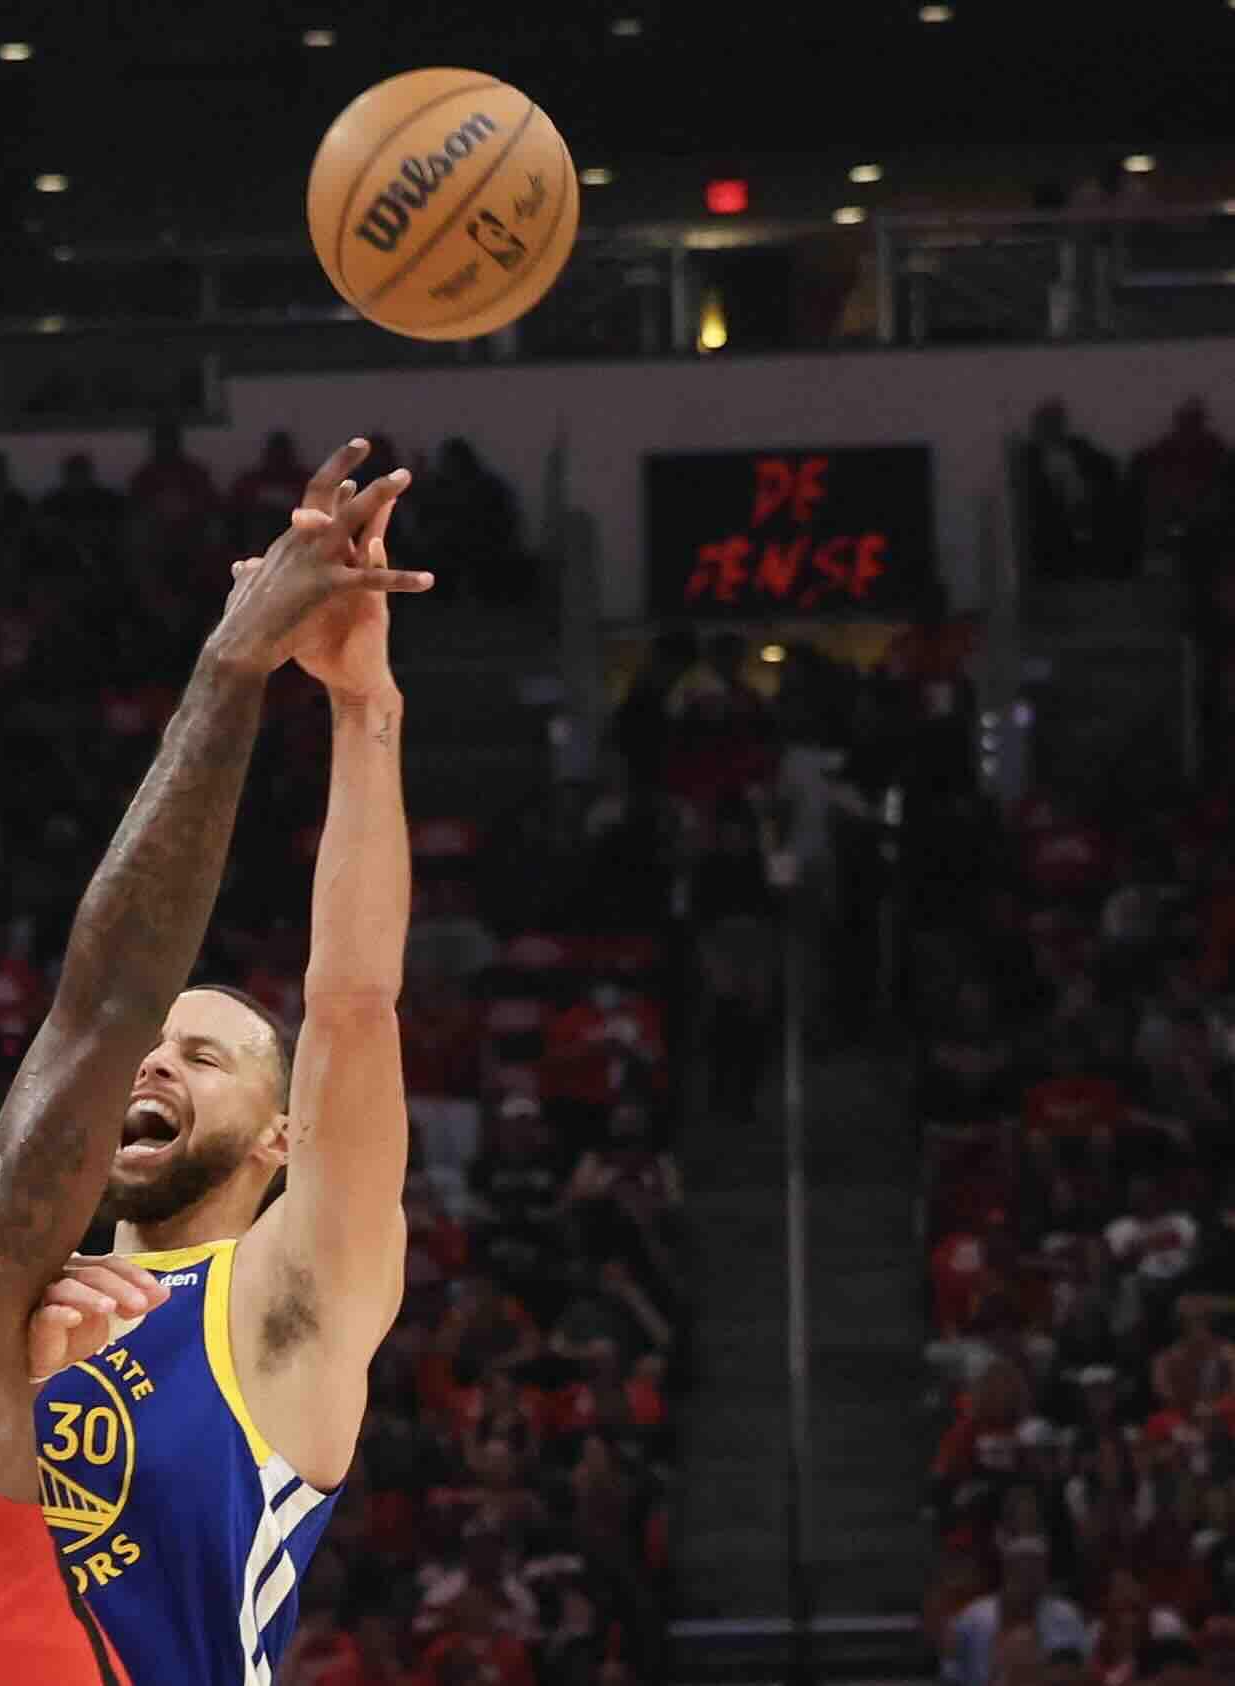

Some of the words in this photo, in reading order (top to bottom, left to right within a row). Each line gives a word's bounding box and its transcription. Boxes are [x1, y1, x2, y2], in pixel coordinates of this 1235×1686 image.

[355, 112, 497, 253] Wilson
[160, 1273, 198, 1287] ten
[106, 1348, 155, 1401] ATE
[43, 1402, 118, 1465] 30
